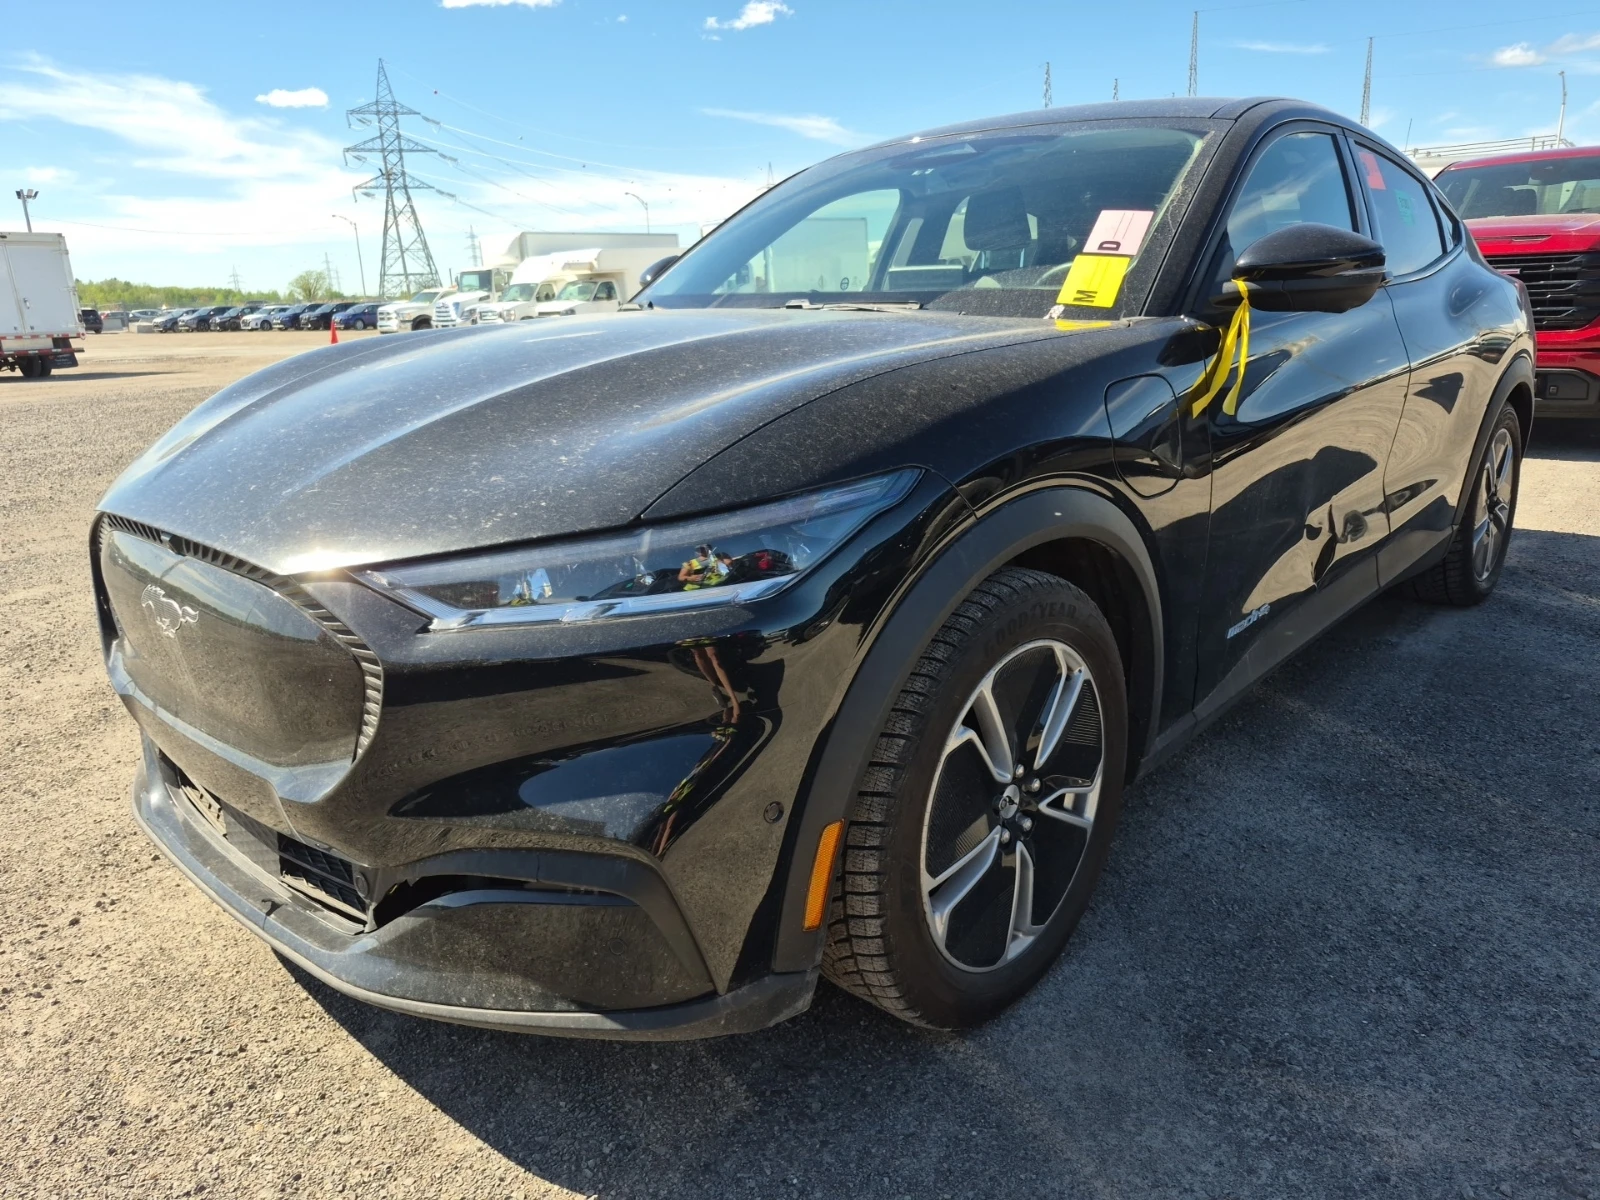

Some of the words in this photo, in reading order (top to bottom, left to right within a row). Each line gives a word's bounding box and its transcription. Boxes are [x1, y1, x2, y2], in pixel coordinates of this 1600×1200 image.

[1098, 241, 1121, 251] D
[1073, 290, 1098, 303] M
[983, 601, 1077, 658] GOODYEAR
